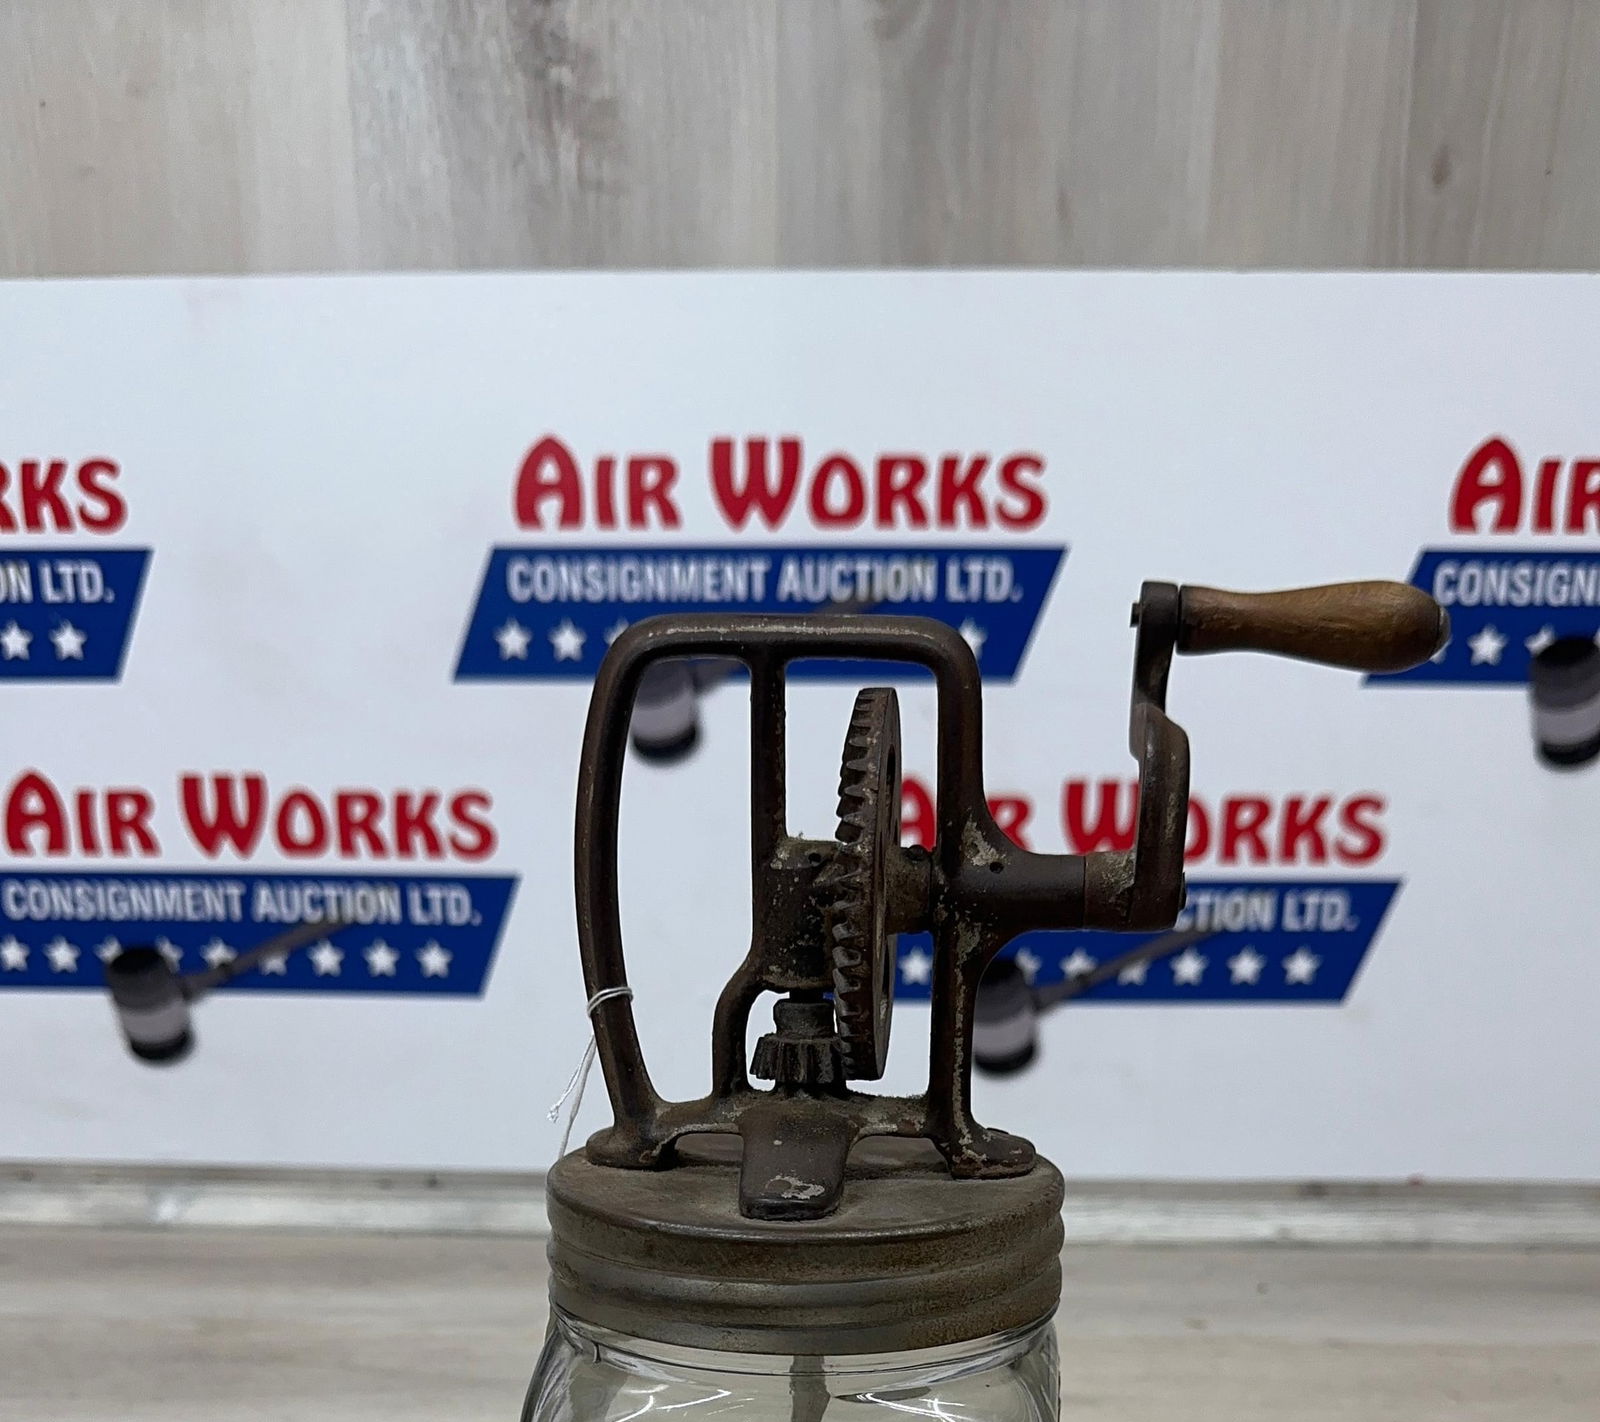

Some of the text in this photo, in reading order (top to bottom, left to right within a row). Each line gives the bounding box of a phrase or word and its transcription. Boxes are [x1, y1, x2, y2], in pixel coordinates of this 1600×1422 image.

[512, 433, 1047, 532] AIR WORKS
[1449, 434, 1600, 534] AIR
[39, 560, 115, 602] LTD.
[506, 555, 1024, 602] CONSIGNMENT AUCTION LTD.
[1433, 561, 1600, 605] CONSIGN
[2, 768, 496, 862] AIR WORKS
[2, 879, 482, 926] CONSIGNMENT AUCTION LTD.
[1281, 889, 1360, 931] LTD.
